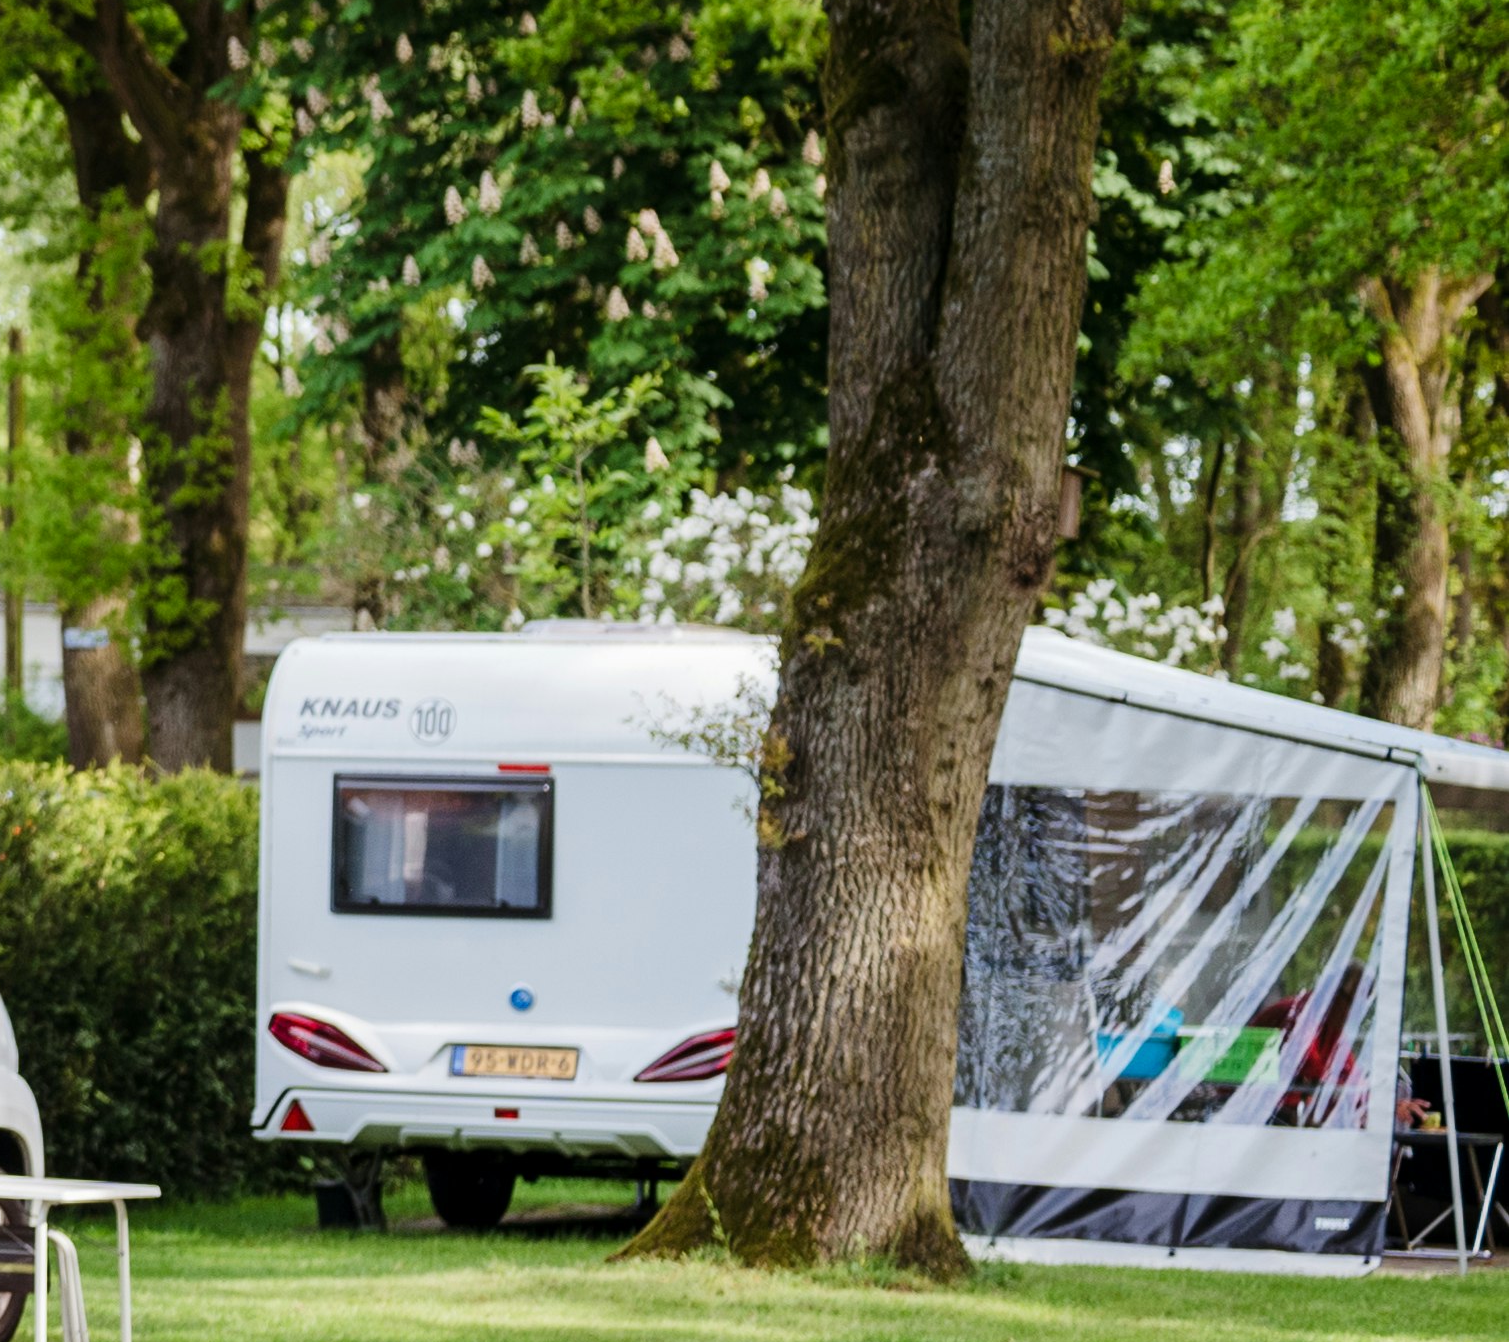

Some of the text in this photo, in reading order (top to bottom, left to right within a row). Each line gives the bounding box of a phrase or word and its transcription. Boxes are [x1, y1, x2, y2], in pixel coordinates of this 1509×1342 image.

[299, 697, 402, 719] KNAUS
[298, 722, 349, 740] Sport
[415, 704, 452, 737] 100
